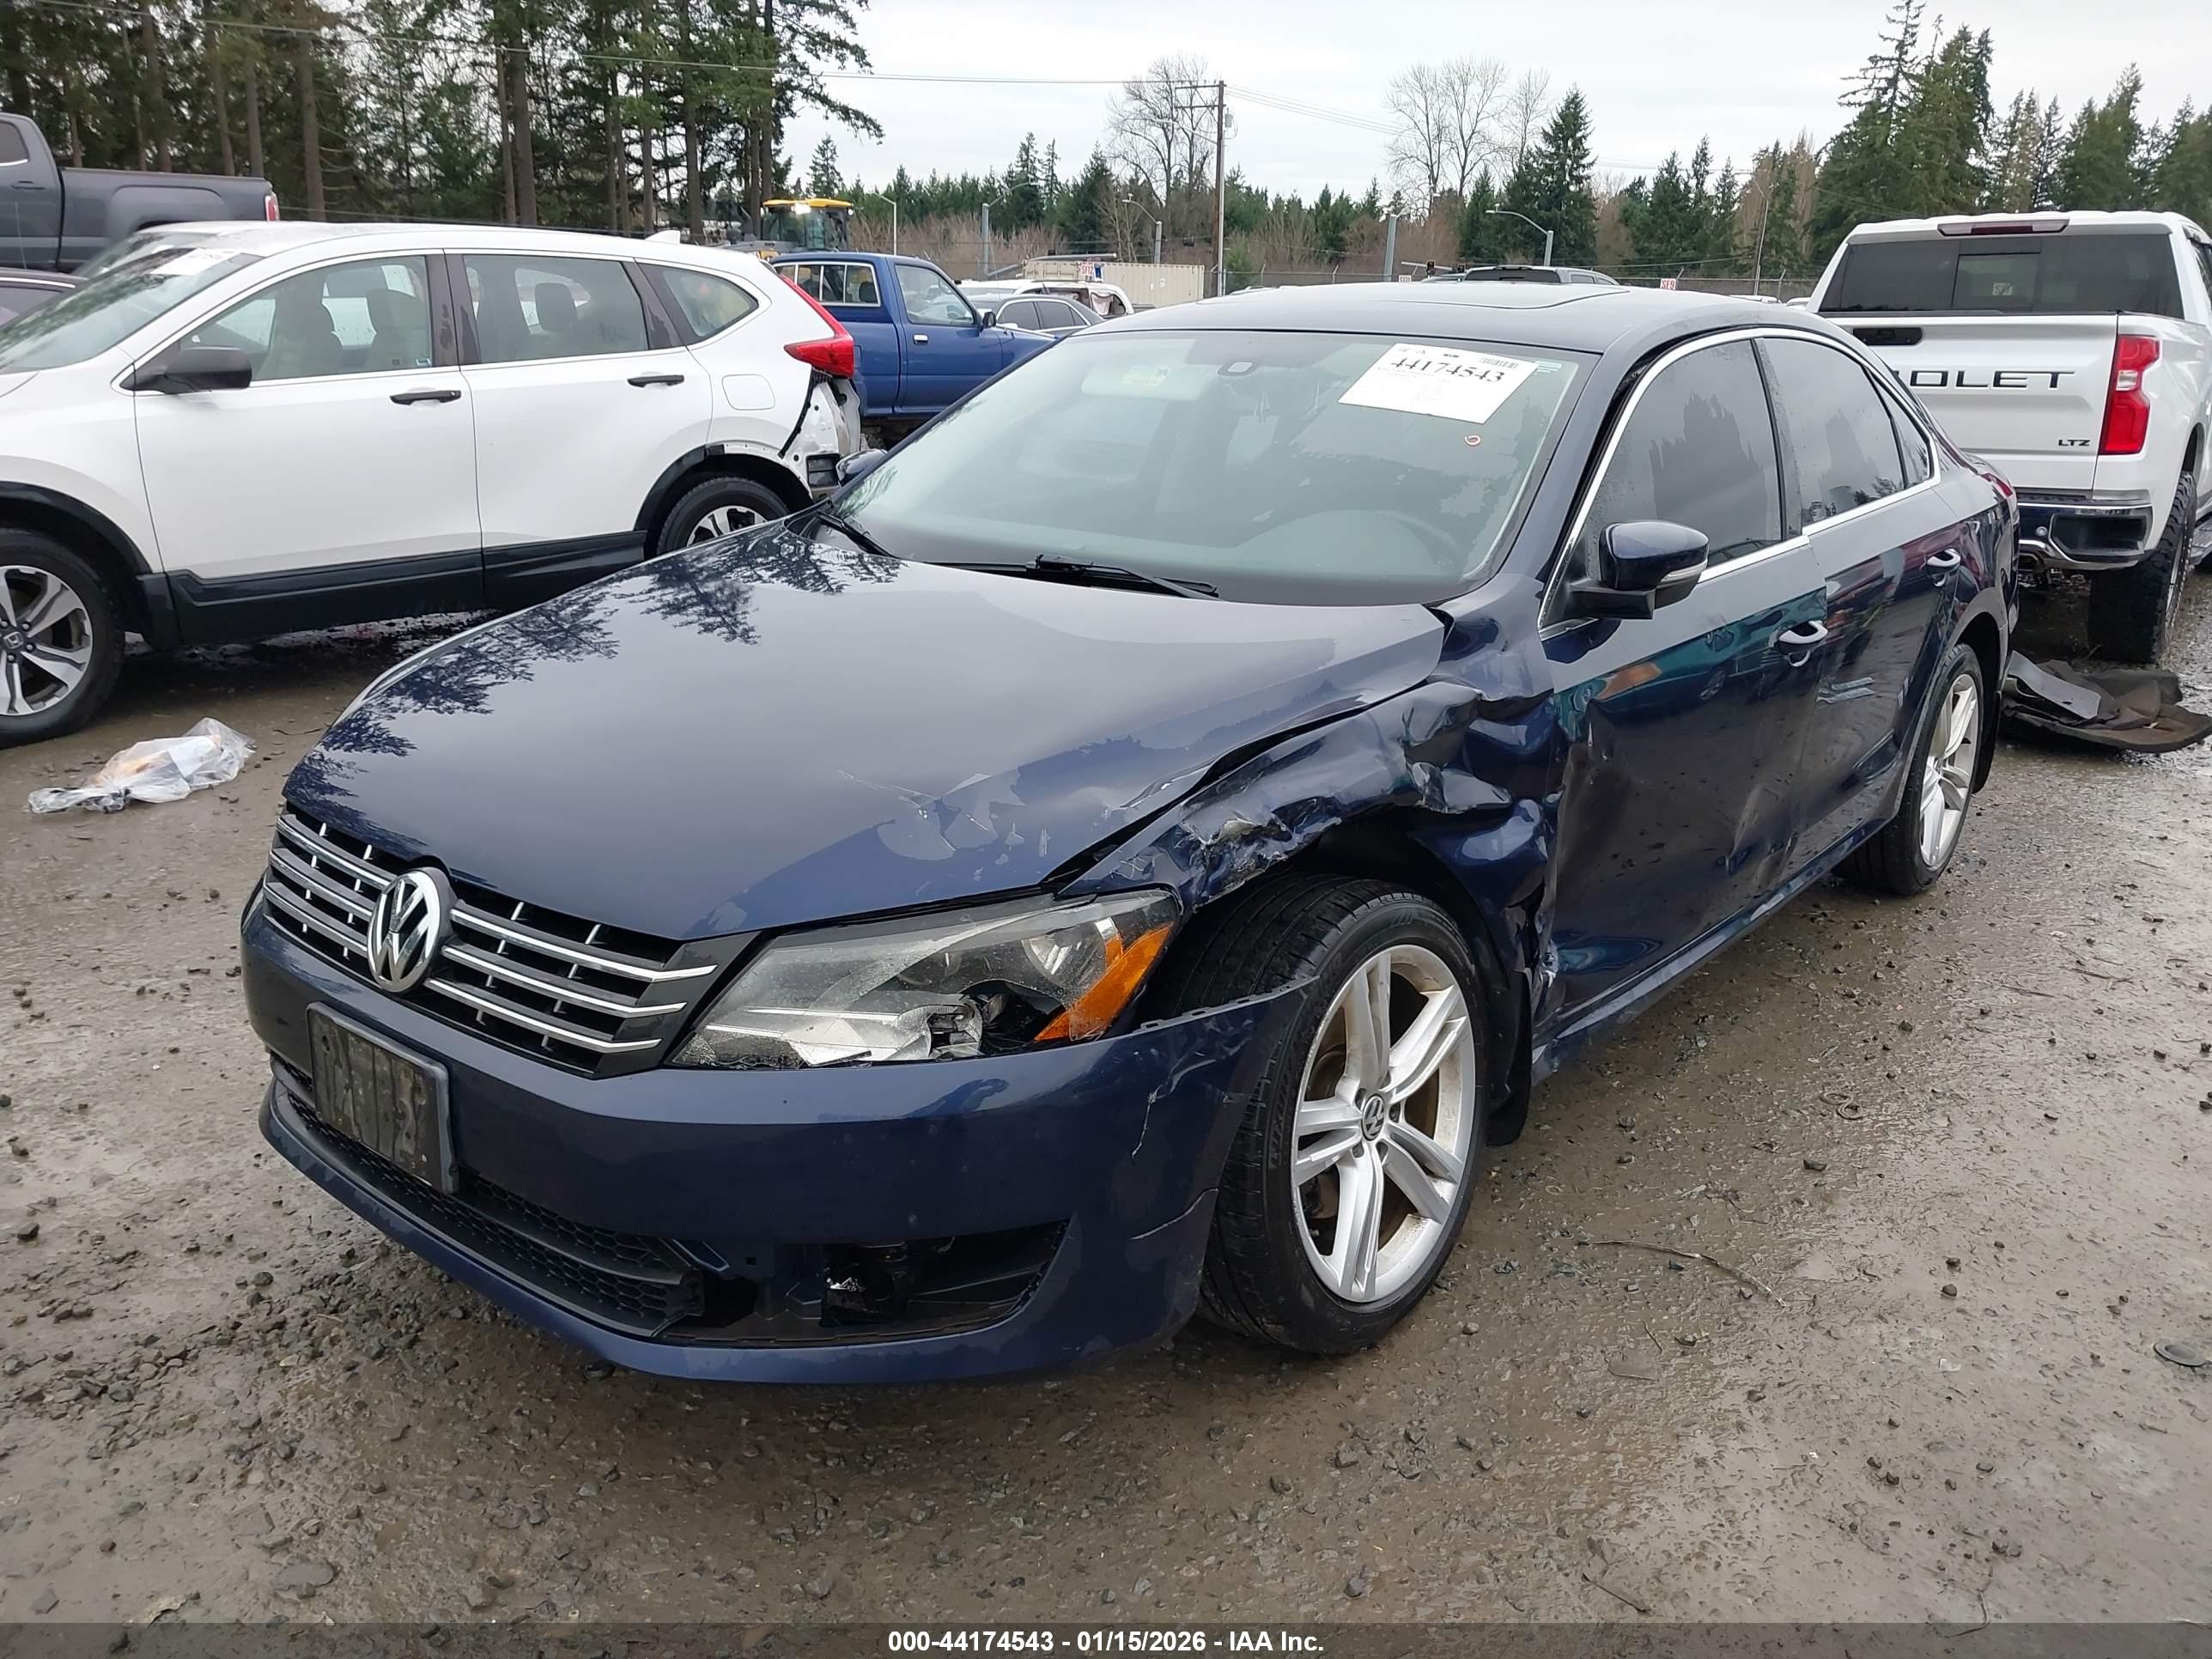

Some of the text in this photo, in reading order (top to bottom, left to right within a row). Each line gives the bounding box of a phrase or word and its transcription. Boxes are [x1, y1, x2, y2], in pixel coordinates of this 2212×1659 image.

[1391, 357, 1505, 383] 44174543
[1893, 370, 2075, 389] OLET
[2057, 439, 2091, 447] LTZ
